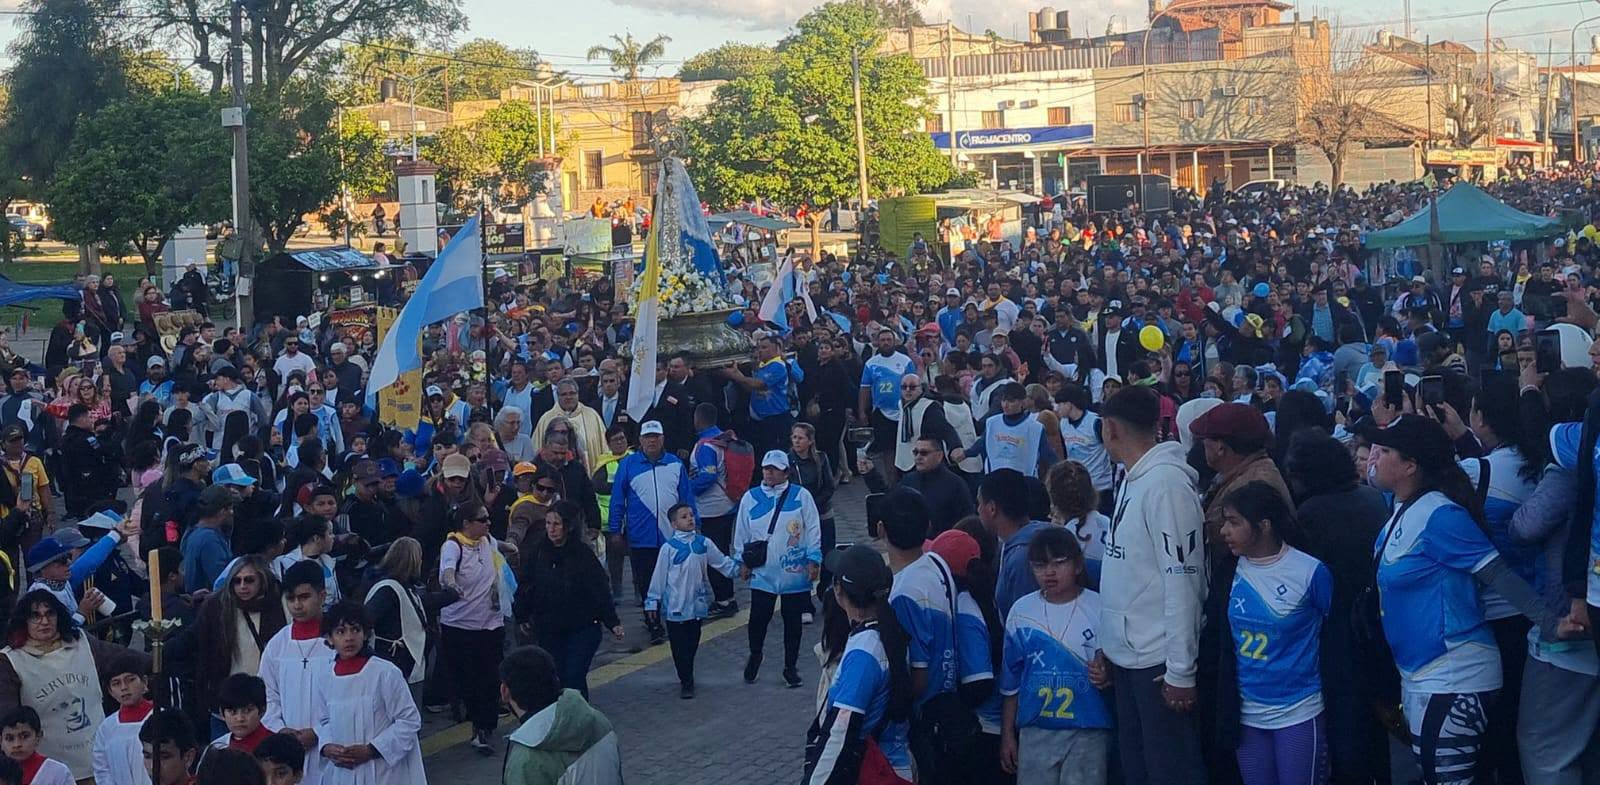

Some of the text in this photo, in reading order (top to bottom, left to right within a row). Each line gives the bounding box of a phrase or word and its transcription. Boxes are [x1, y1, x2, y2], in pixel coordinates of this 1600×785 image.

[971, 133, 1032, 145] FARMACENTRO
[879, 382, 893, 394] 22
[1240, 630, 1268, 660] 22
[36, 673, 89, 701] SERVIDOR
[1038, 687, 1074, 719] 22
